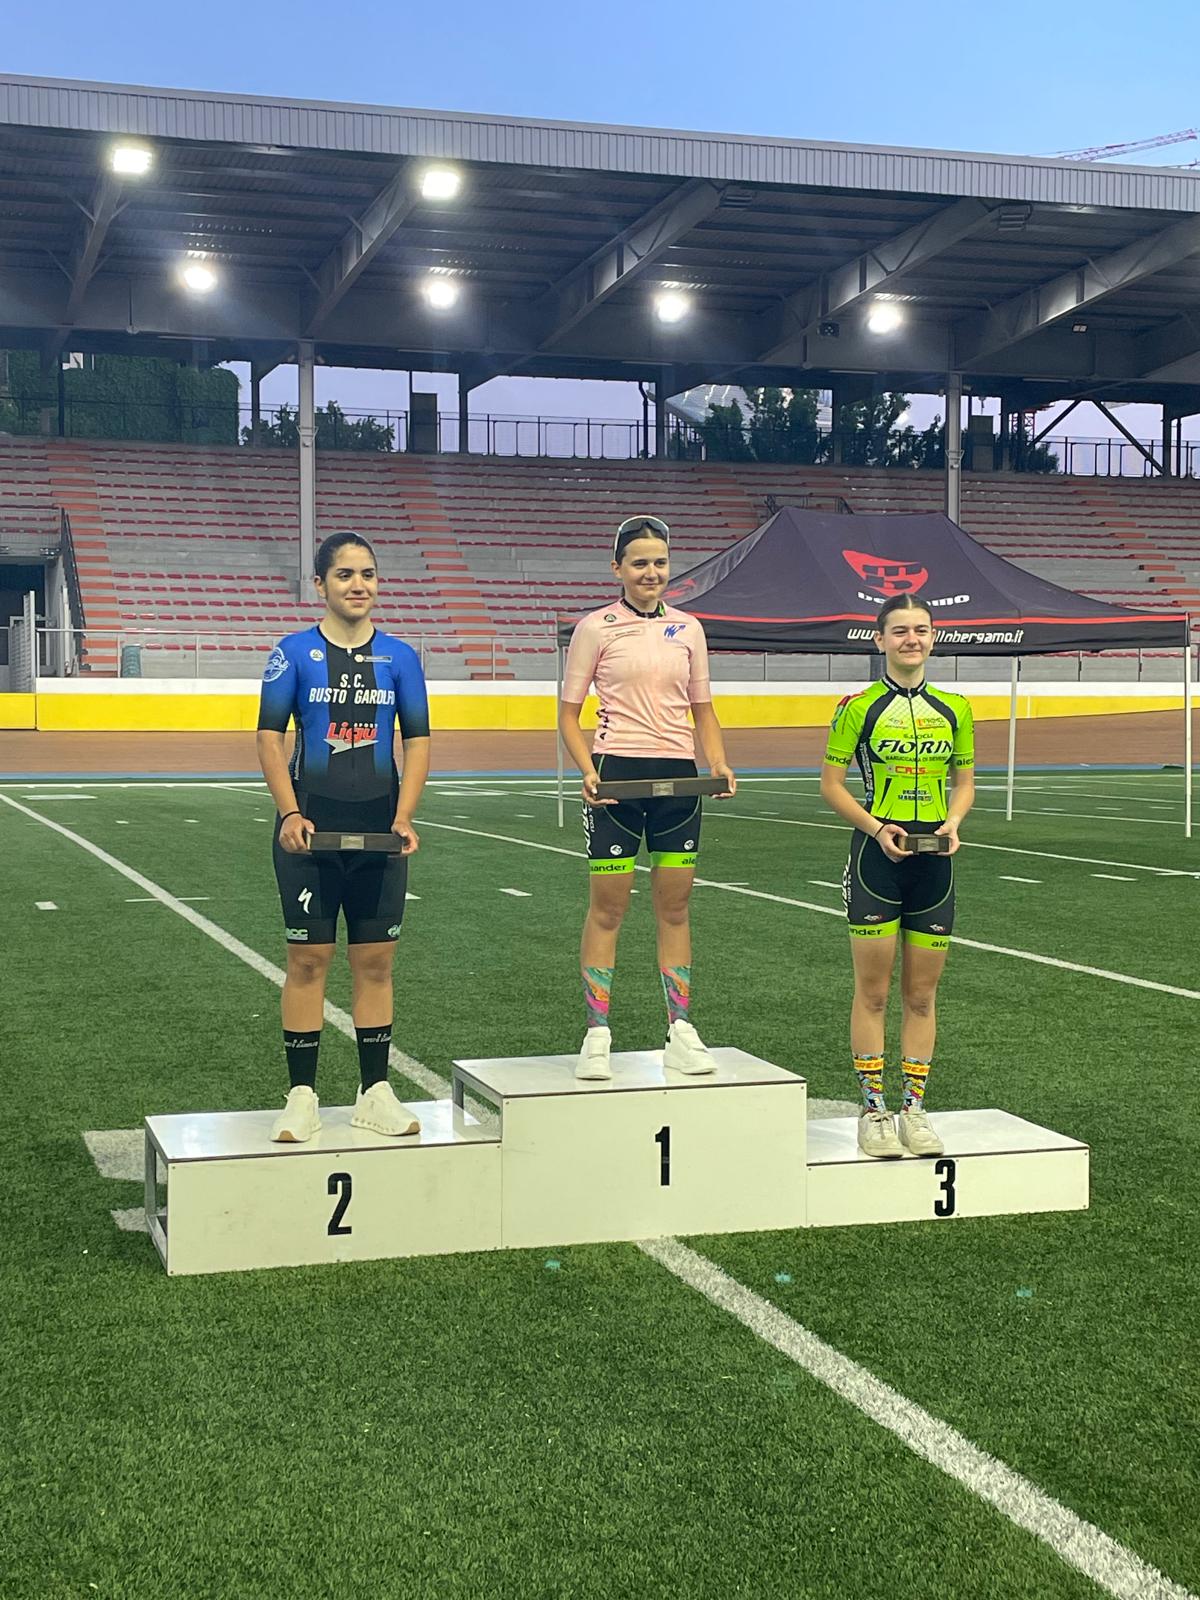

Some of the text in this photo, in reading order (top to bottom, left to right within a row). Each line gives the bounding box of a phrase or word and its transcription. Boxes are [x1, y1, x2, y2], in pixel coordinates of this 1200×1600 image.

[308, 687, 348, 704] BUSTO
[655, 1126, 670, 1186] 1
[327, 1172, 352, 1236] 2
[934, 1159, 956, 1217] 3
